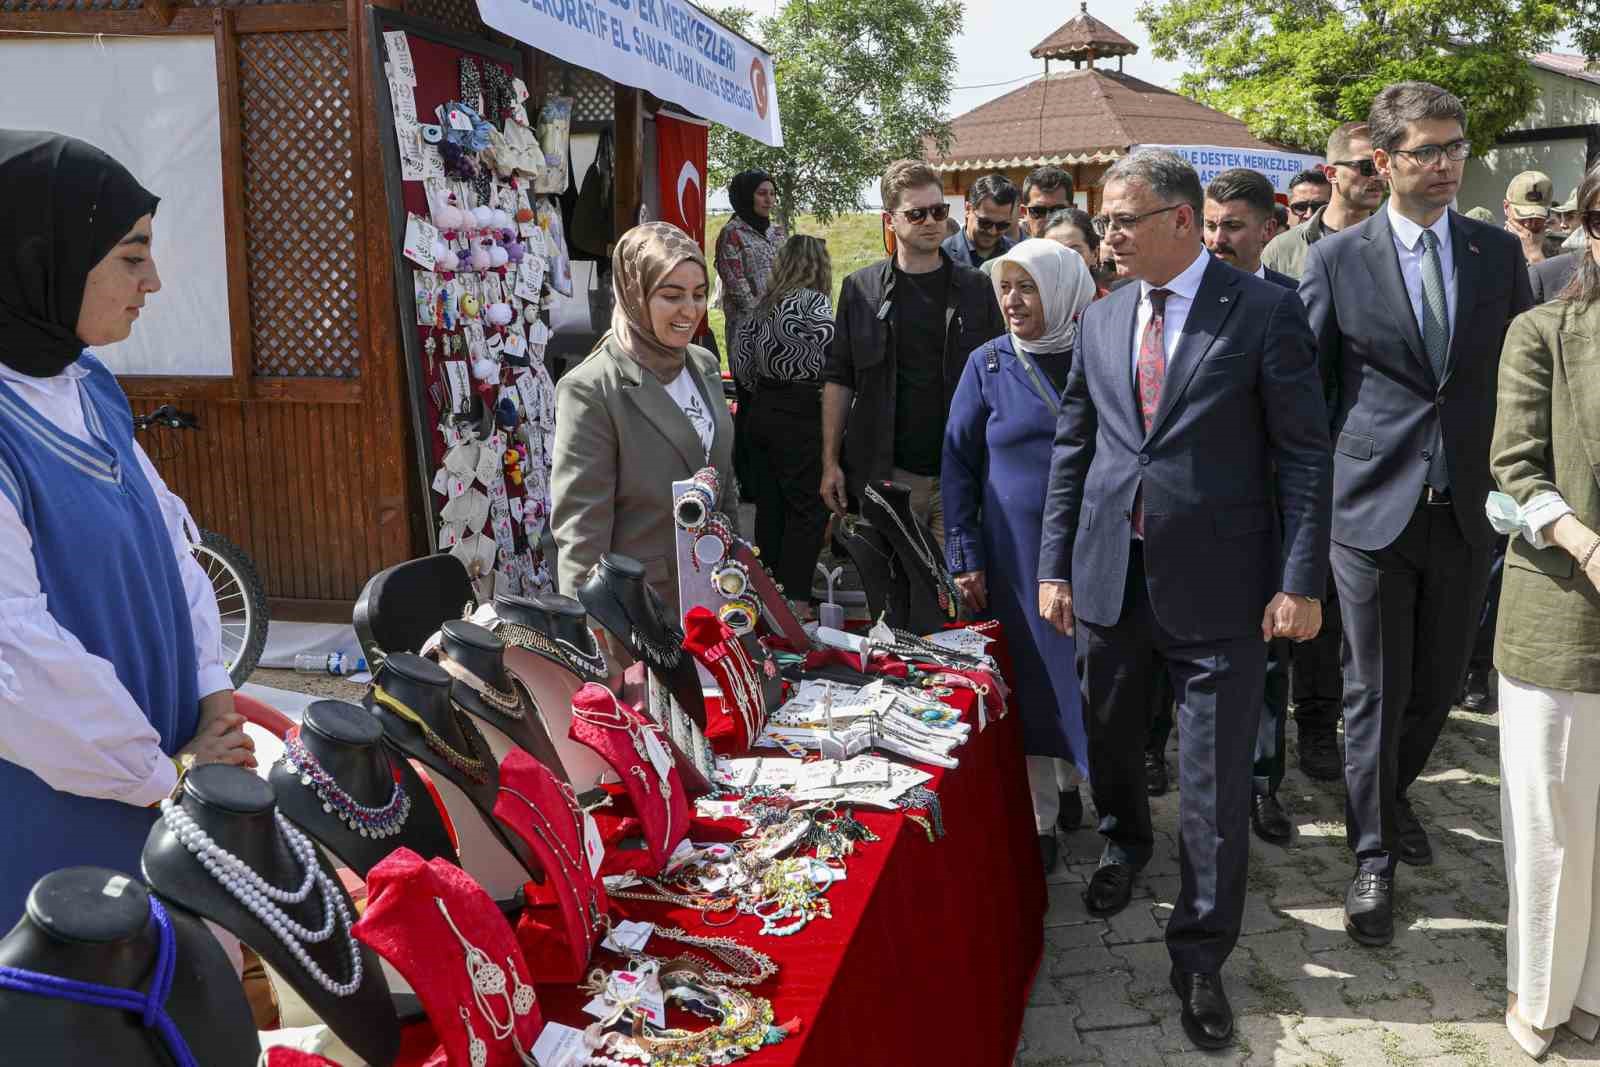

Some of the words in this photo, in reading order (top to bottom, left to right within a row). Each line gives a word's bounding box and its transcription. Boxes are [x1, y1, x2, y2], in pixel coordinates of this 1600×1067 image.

[610, 16, 631, 52] EL
[632, 25, 695, 86] SANATLARI
[695, 60, 720, 97] KURS
[1200, 151, 1240, 168] DESTEK
